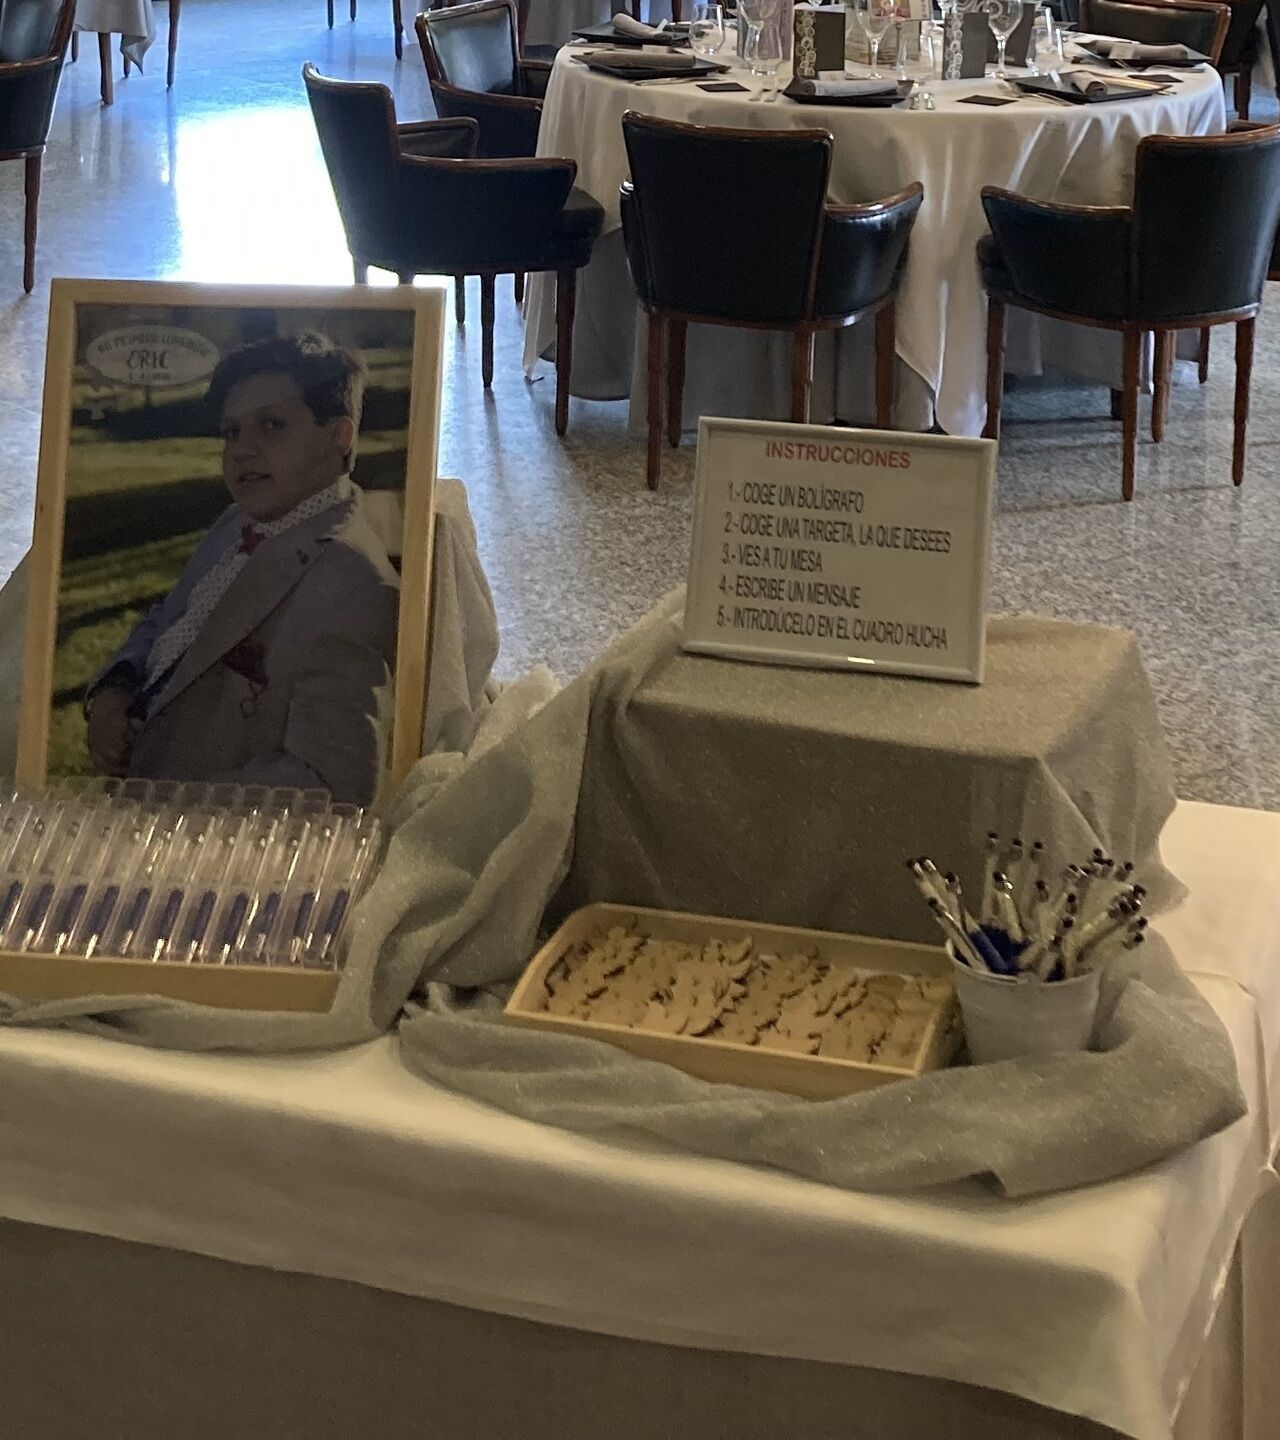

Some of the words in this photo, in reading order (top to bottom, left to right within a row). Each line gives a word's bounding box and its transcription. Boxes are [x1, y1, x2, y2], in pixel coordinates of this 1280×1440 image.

[126, 349, 169, 369] ERIC
[766, 440, 911, 469] INSTRUCCIONES
[743, 482, 776, 505] COGE
[779, 484, 796, 507] UN
[740, 513, 773, 537] COGE
[776, 516, 800, 539] UNA
[859, 523, 874, 545] LA
[876, 525, 901, 548] QUE
[903, 527, 952, 553] DESEES
[737, 543, 762, 567] VES
[762, 547, 770, 568] A
[772, 546, 788, 570] TU
[790, 548, 823, 572] MESA
[736, 575, 786, 601] ESCRIBE
[788, 580, 805, 602] UN
[807, 581, 862, 609] MENSAJE
[817, 615, 834, 638] EN
[836, 616, 851, 640] EL
[853, 617, 904, 645] CUADRO
[905, 623, 948, 650] HUCHA
